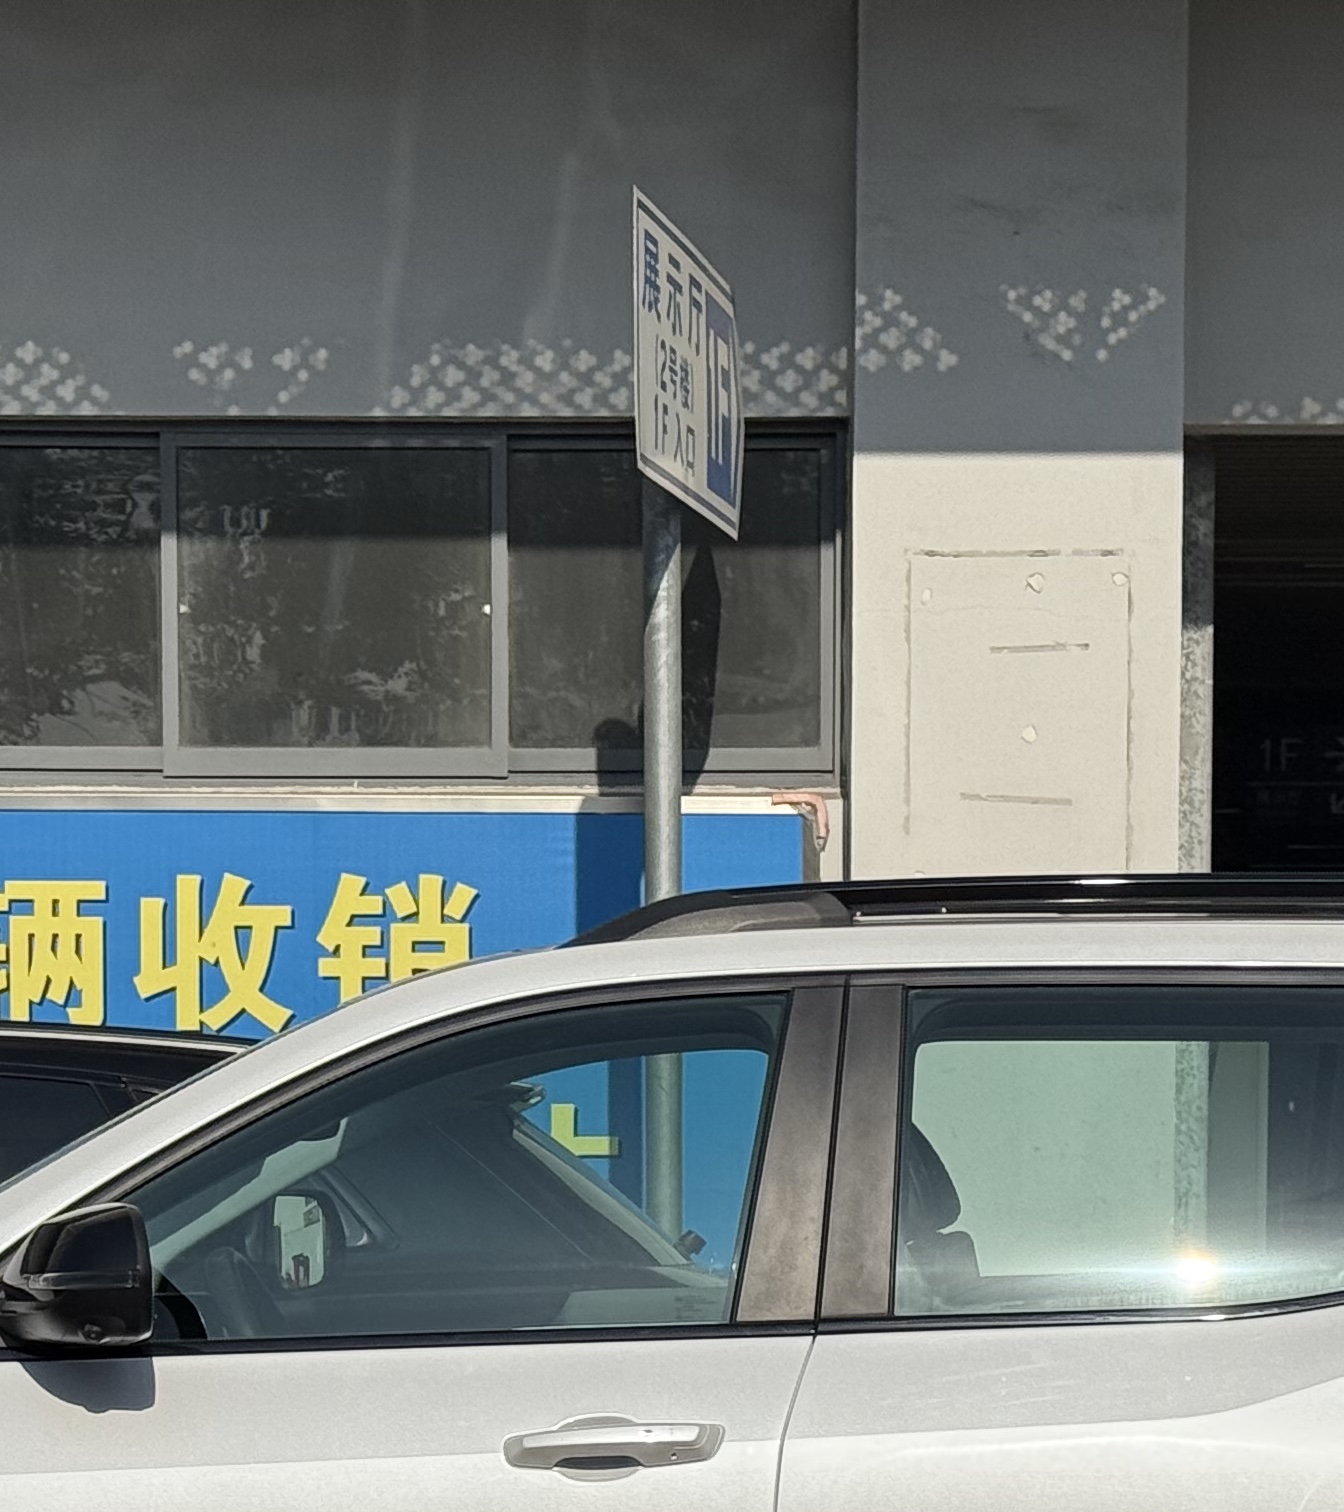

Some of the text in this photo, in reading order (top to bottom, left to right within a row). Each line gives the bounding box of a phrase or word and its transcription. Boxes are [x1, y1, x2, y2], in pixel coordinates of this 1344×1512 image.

[642, 228, 703, 357] 展示厅
[708, 328, 729, 466] 1F
[1259, 738, 1304, 773] 1F
